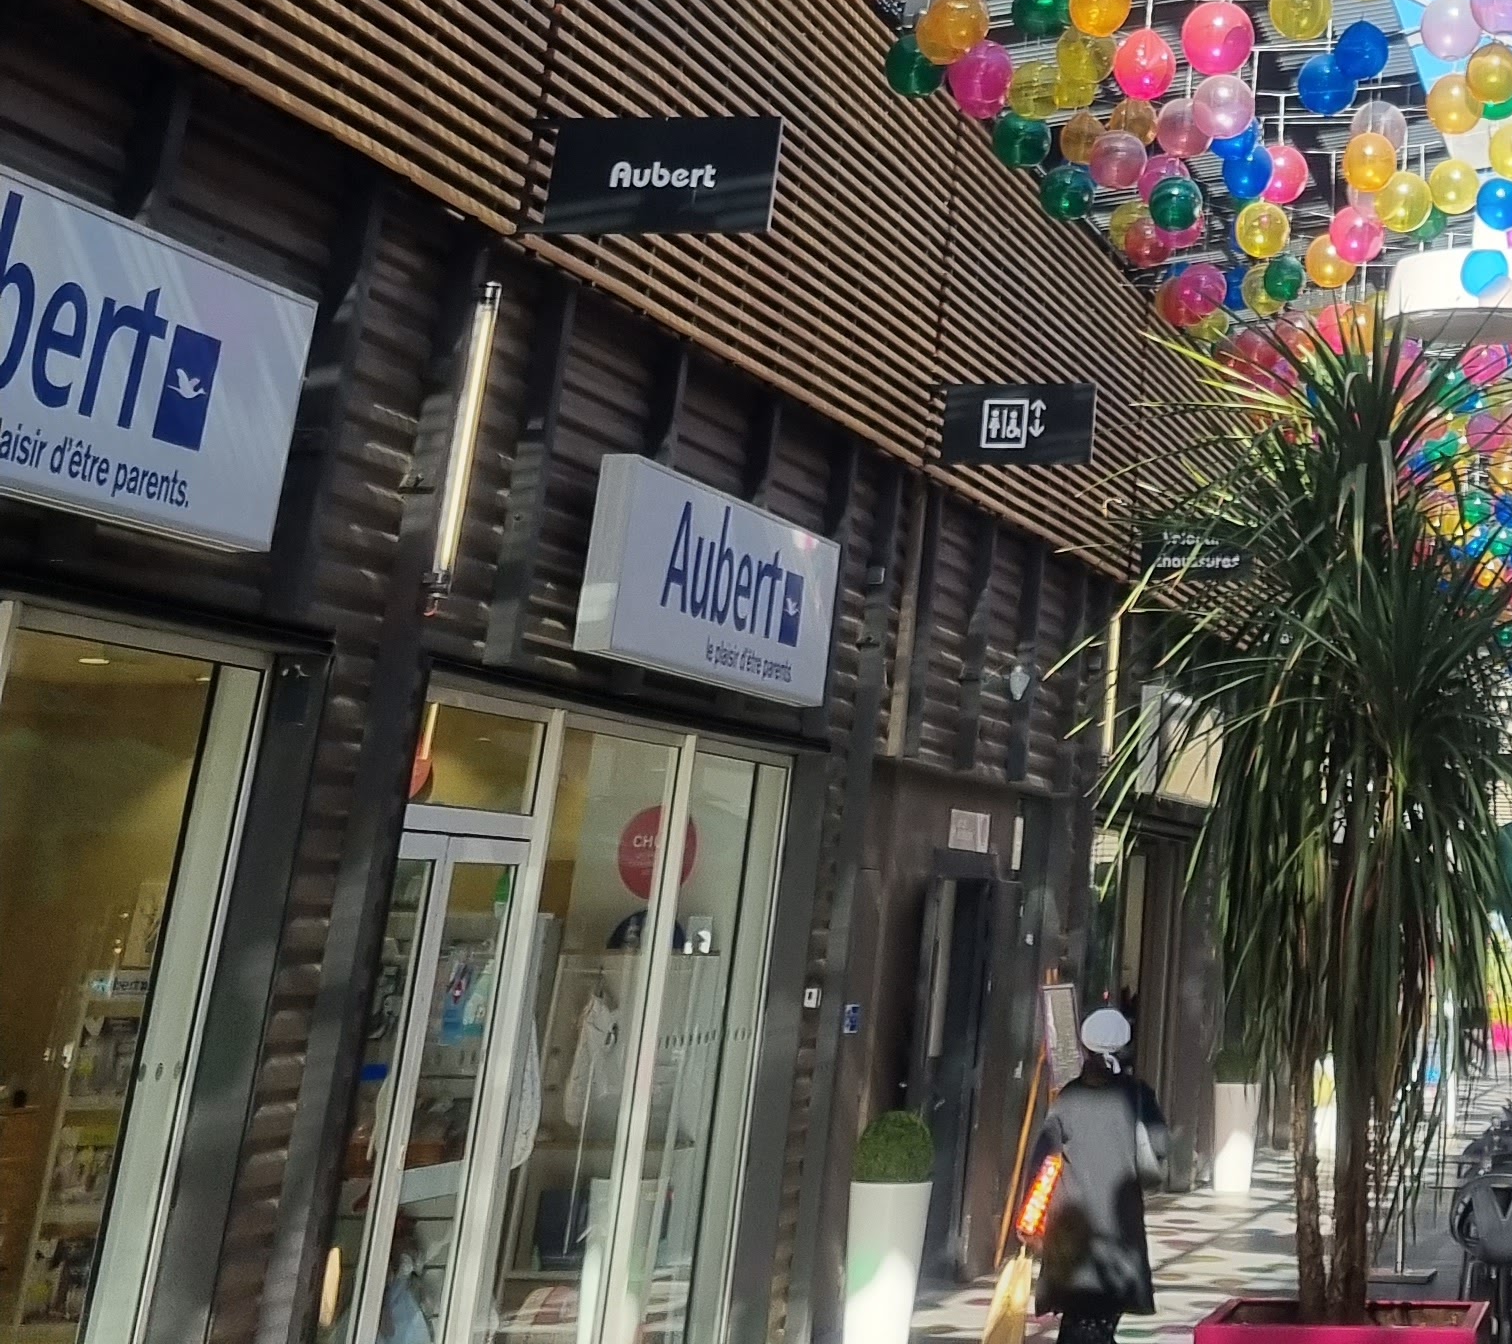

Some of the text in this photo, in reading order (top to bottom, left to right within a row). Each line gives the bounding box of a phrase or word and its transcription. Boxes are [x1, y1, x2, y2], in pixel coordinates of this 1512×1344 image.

[608, 160, 717, 188] Aubert
[0, 419, 190, 508] aisir d'être parents.
[659, 500, 784, 640] Aubert
